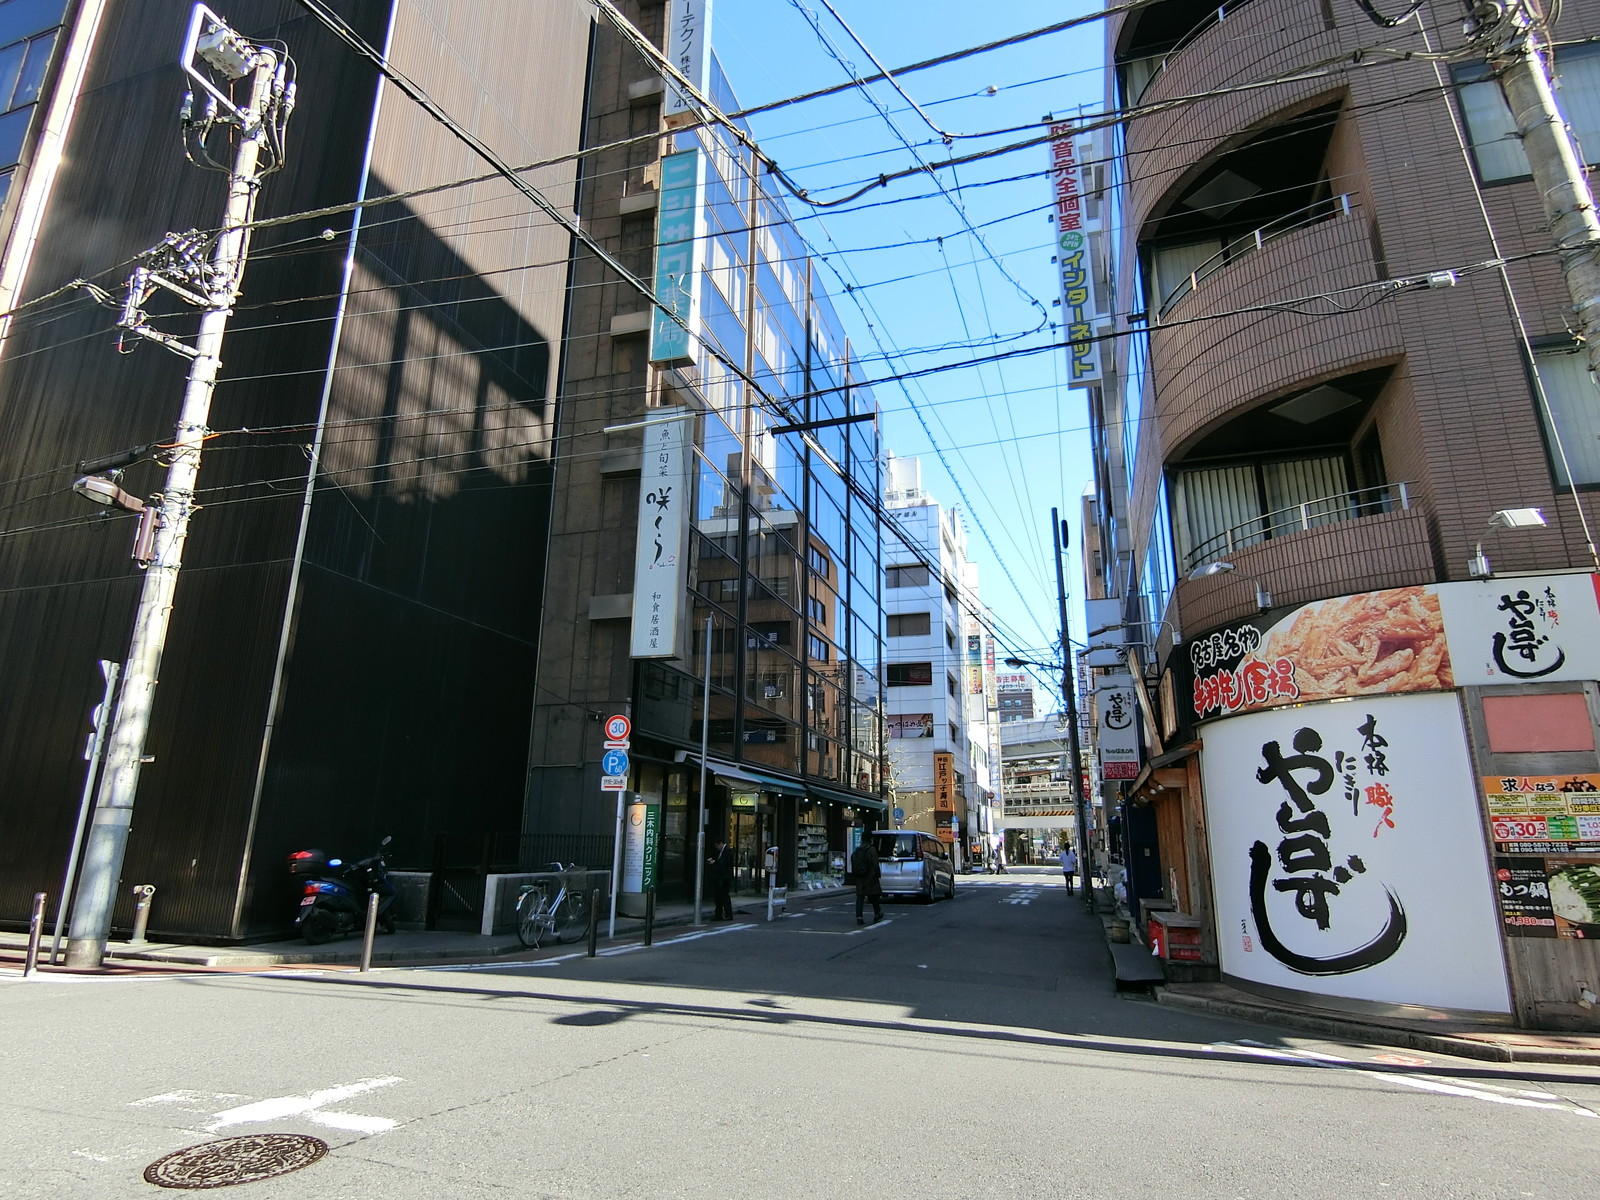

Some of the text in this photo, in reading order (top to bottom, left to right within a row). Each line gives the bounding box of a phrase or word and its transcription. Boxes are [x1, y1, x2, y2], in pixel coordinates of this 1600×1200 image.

[1050, 124, 1082, 233] 防音完全個室
[1063, 250, 1095, 379] インターネット
[645, 486, 672, 565] 咲くら
[649, 591, 661, 649] 和食居酒屋
[1190, 624, 1262, 675] 名古屋名物
[611, 722, 625, 733] 30
[608, 756, 619, 773] P
[1501, 777, 1556, 792] 求人なう
[644, 811, 655, 885] 三木内科クリニック
[1500, 881, 1549, 899] もつ鍋
